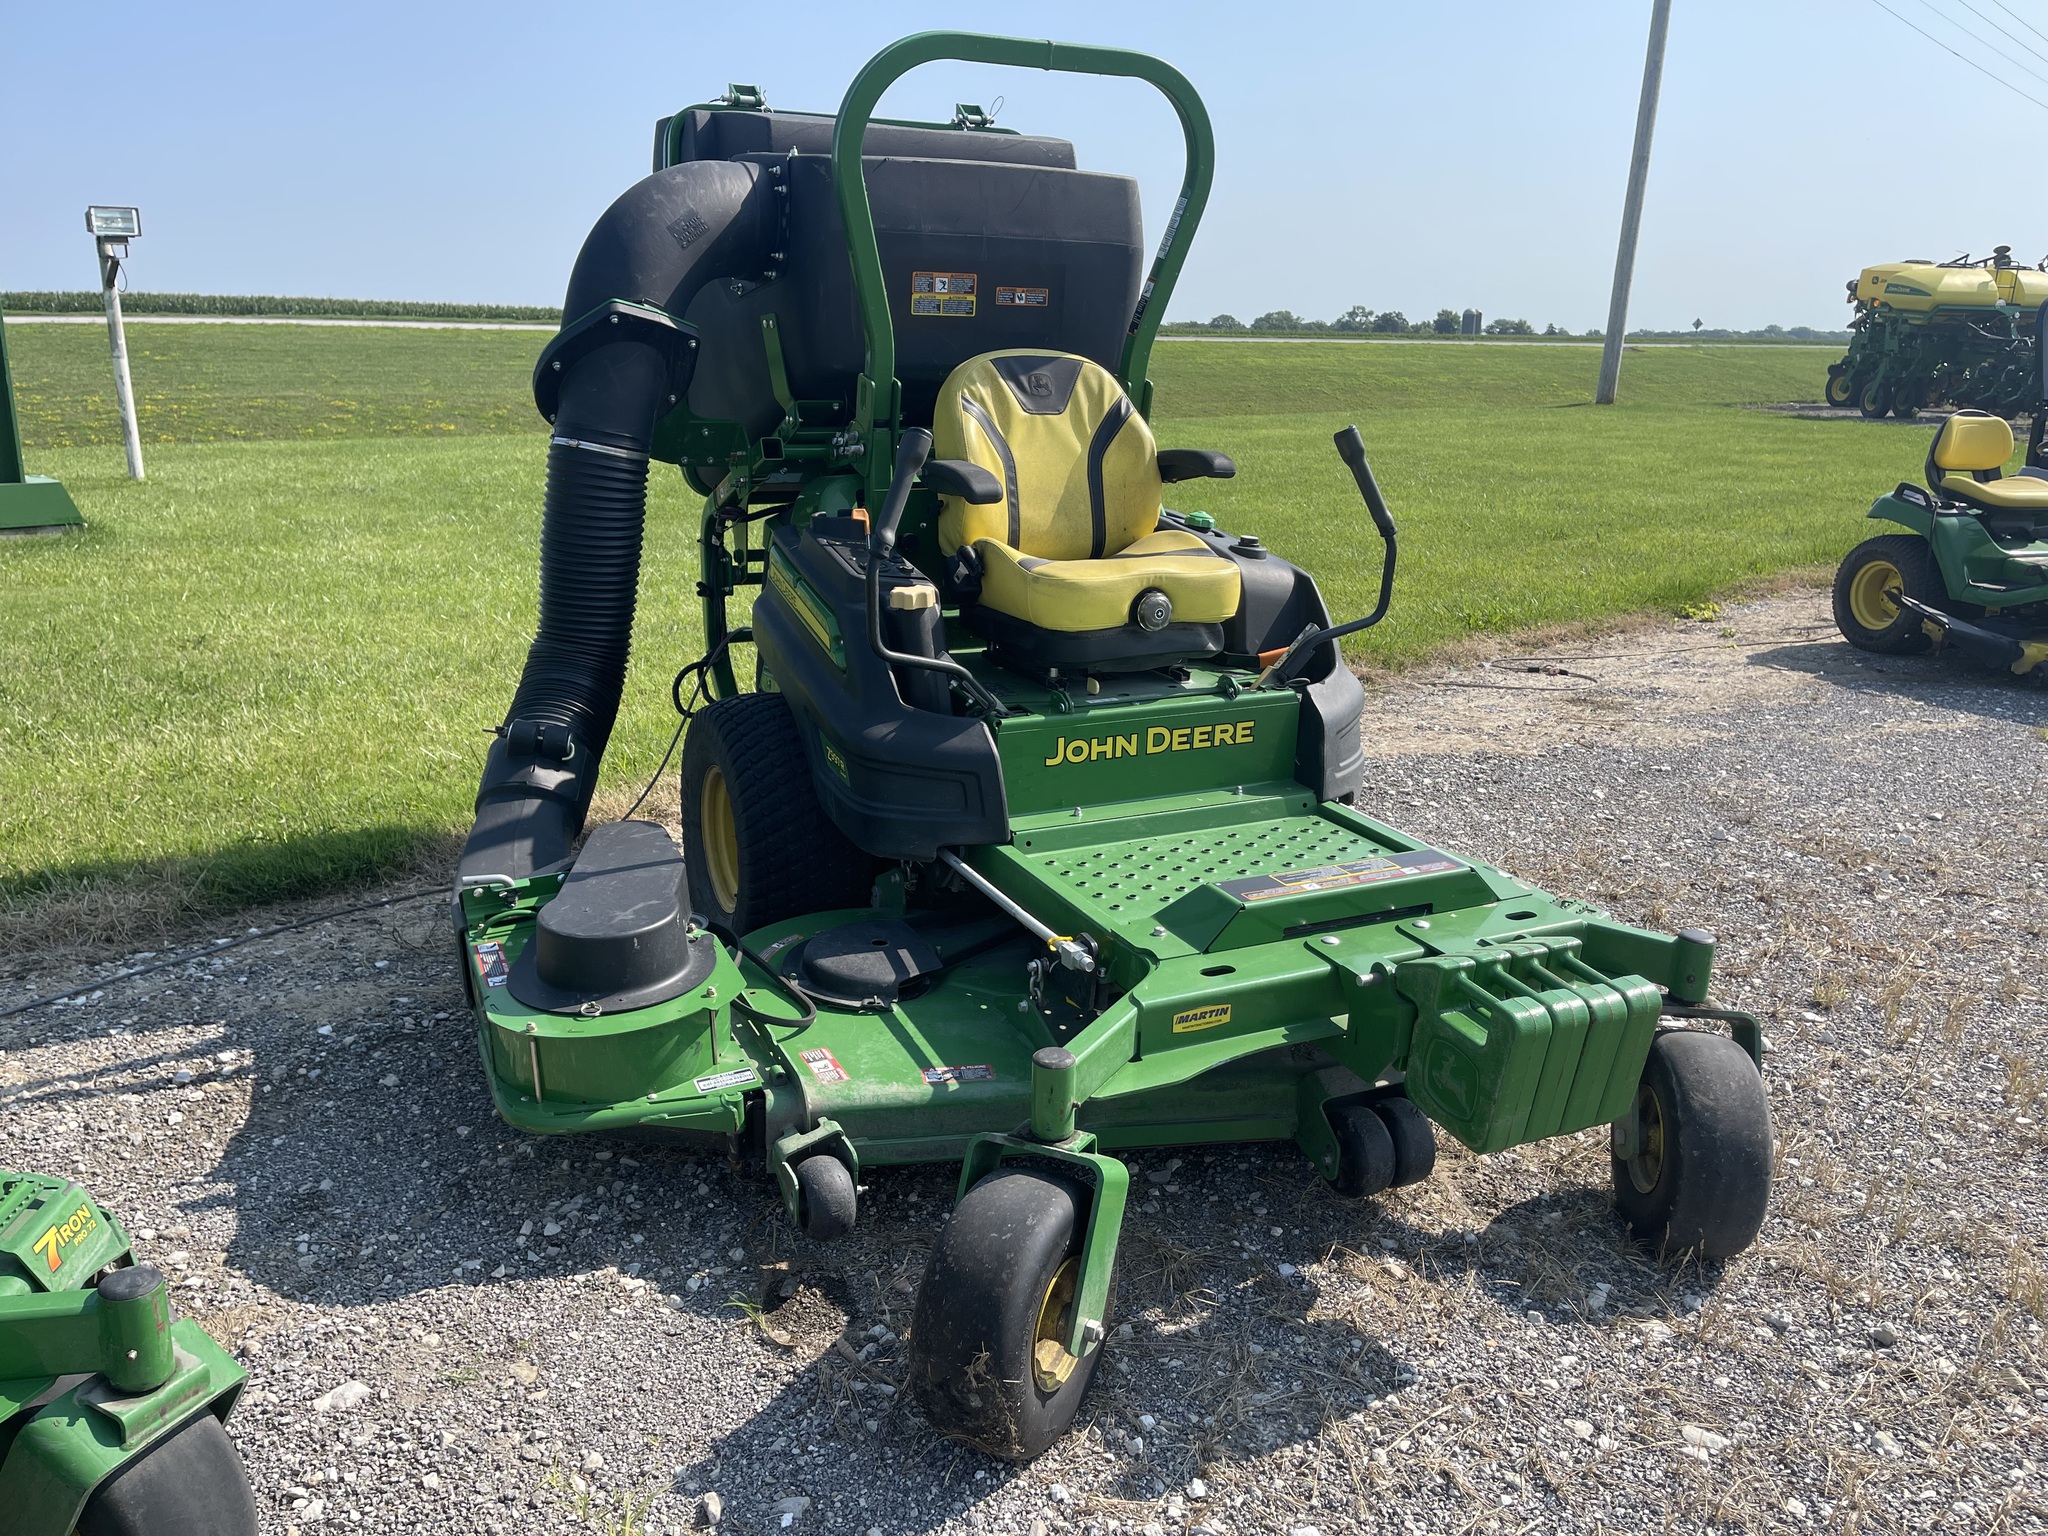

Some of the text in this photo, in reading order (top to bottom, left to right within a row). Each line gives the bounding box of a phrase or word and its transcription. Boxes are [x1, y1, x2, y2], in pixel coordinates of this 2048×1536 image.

[1045, 720, 1255, 766] JOHN DEERE
[1175, 1006, 1229, 1025] MARTIN
[73, 1219, 97, 1247] PRO 72
